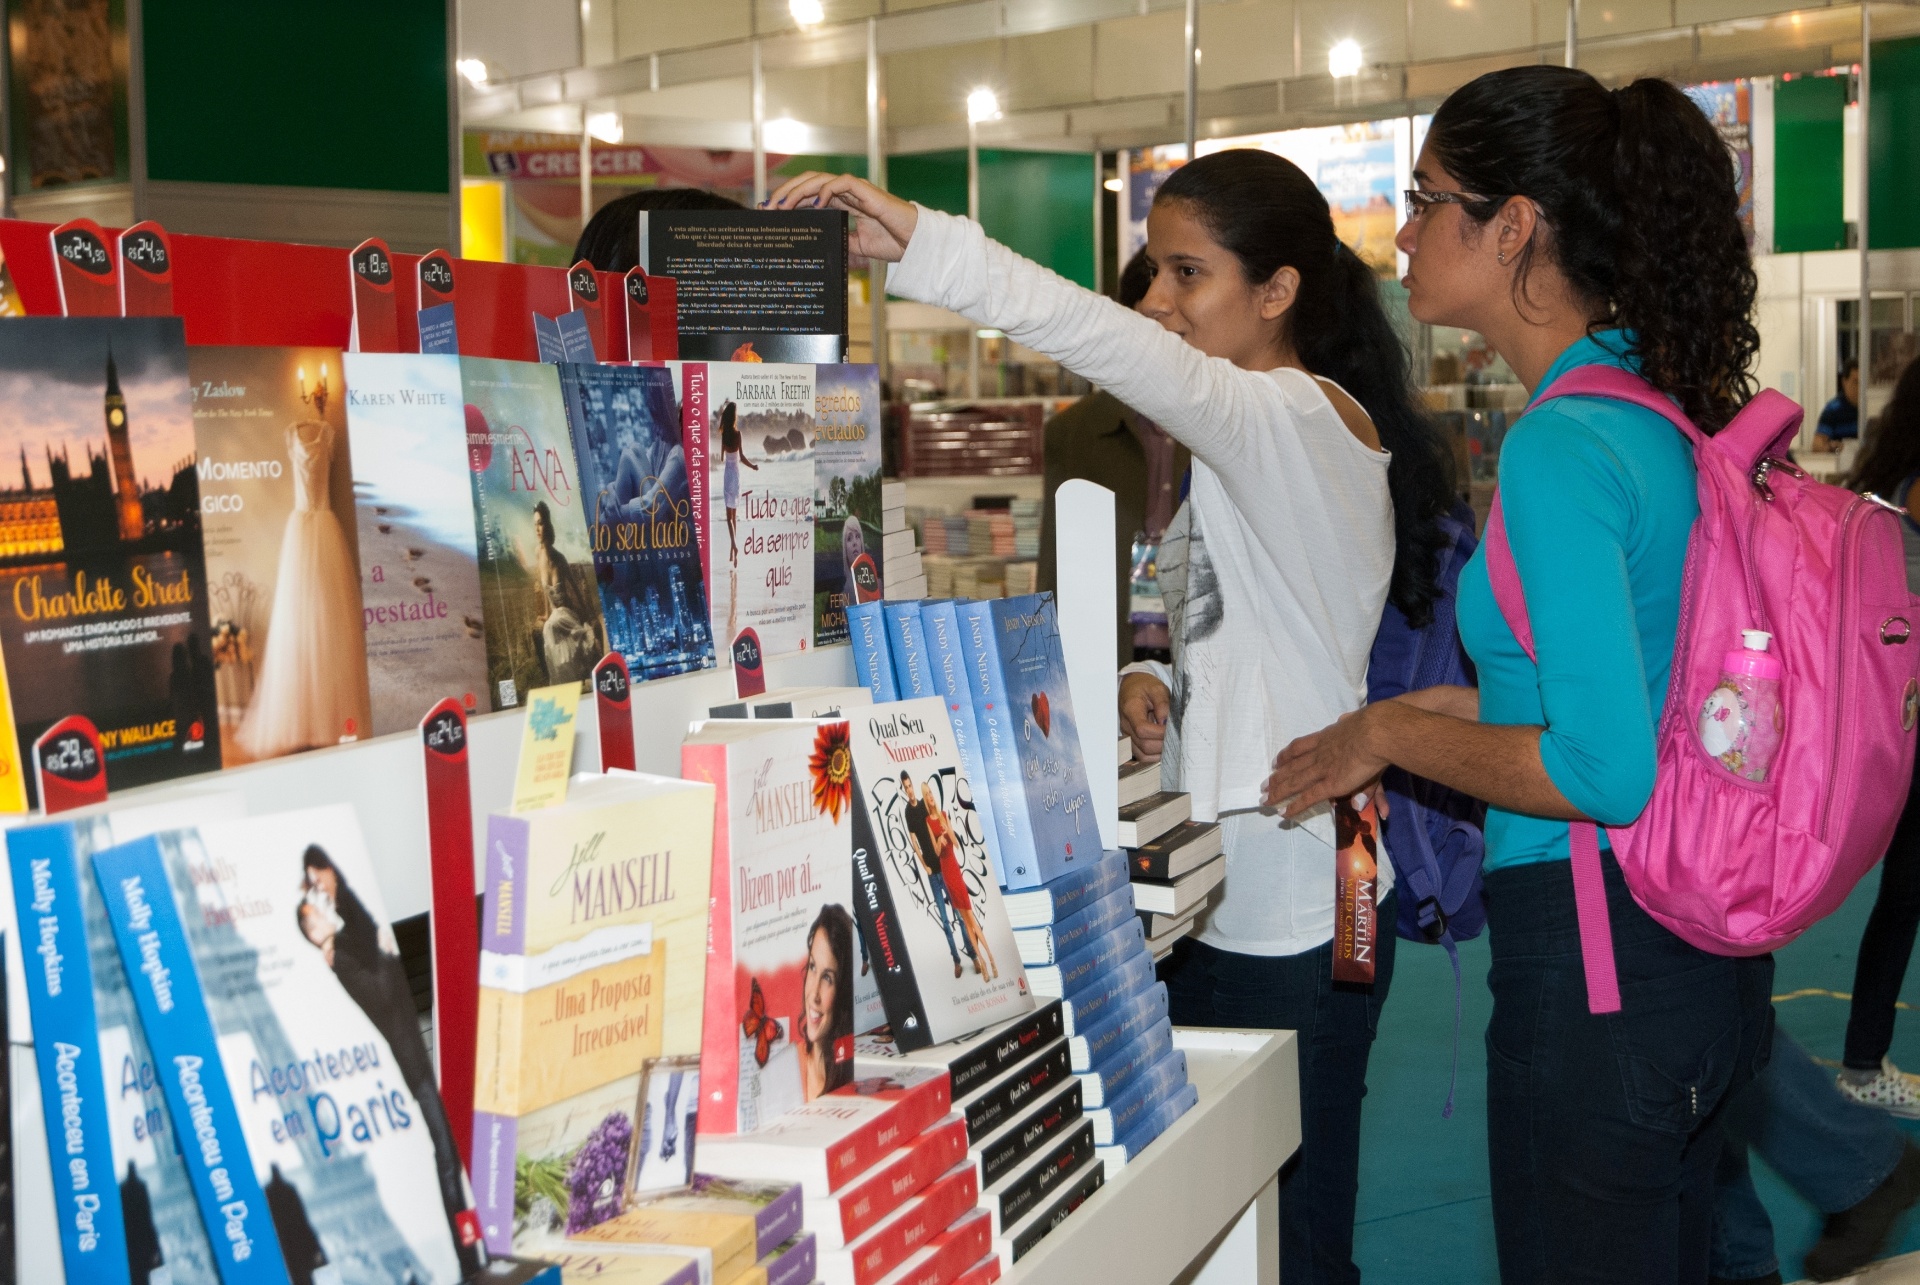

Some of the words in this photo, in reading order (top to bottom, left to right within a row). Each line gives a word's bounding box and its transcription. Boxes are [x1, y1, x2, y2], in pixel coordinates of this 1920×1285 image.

[527, 150, 645, 176] CRECER
[203, 382, 247, 398] Zaslow
[350, 389, 395, 405] KAREN
[400, 389, 447, 405] WHITE
[691, 372, 704, 404] Tudo
[736, 381, 776, 400] BARBARA
[781, 381, 811, 400] FREETHY
[815, 386, 861, 421] egredos
[691, 407, 701, 416] o
[815, 416, 865, 441] evelados
[687, 420, 701, 444] que
[199, 457, 282, 480] MOMENTO
[508, 427, 572, 491] ANA
[691, 447, 705, 466] ela
[690, 470, 703, 519] sempre
[741, 489, 778, 520] Tudo
[780, 503, 790, 518] o
[790, 496, 811, 525] que
[616, 522, 647, 550] seu
[744, 528, 764, 556] ela
[767, 530, 810, 560] sempre
[372, 566, 385, 583] a
[765, 558, 793, 598] quis
[13, 570, 127, 622] Charlotte
[131, 564, 194, 608] Street
[362, 594, 448, 630] pestade
[860, 615, 875, 649] JANDY
[868, 652, 882, 694] NELSON
[899, 615, 912, 649] JANDY
[907, 651, 921, 694] NELSON
[934, 616, 949, 651] JANDY
[942, 653, 956, 696] NELSON
[969, 615, 984, 650] JANDY
[977, 651, 991, 695] NELSON
[119, 719, 177, 743] WALLACE
[869, 718, 900, 747] Qual
[900, 713, 925, 736] Seu
[989, 718, 997, 726] O
[990, 728, 1000, 747] céu
[881, 734, 937, 764] Número?
[755, 779, 817, 834] MANSELL
[1001, 809, 1016, 839] lugar
[853, 847, 875, 882] Qual
[30, 858, 57, 913] Molly
[571, 850, 676, 925] MANSELL
[739, 866, 775, 913] Dizem
[777, 865, 797, 911] por
[800, 853, 821, 894] aí...
[864, 882, 879, 910] Seu
[1345, 878, 1354, 912] WILD
[1344, 915, 1353, 959] CARDS
[1356, 879, 1373, 963] MARTIN
[36, 914, 63, 997] Hopkins
[120, 876, 151, 932] Molly
[136, 928, 175, 1014] Hopkins
[871, 910, 901, 974] Número?
[591, 973, 652, 1014] Proposta
[572, 1004, 649, 1058] Irrecusável
[997, 1041, 1010, 1063] Qual
[1009, 1038, 1019, 1052] Seu
[250, 1042, 381, 1104] Aconteceu
[53, 1040, 83, 1156] Aconteceu
[1010, 1084, 1021, 1105] Qual
[1020, 1080, 1031, 1094] Seu
[173, 1054, 219, 1170] Aconteceu
[271, 1111, 308, 1147] em
[307, 1087, 412, 1158] Paris
[1023, 1127, 1035, 1147] Qual
[1034, 1123, 1044, 1137] Seu
[68, 1157, 88, 1191] em
[207, 1167, 237, 1205] em
[1039, 1168, 1050, 1189] Qual
[1049, 1164, 1058, 1177] Seu
[74, 1192, 102, 1254] Paris
[219, 1201, 252, 1263] Paris
